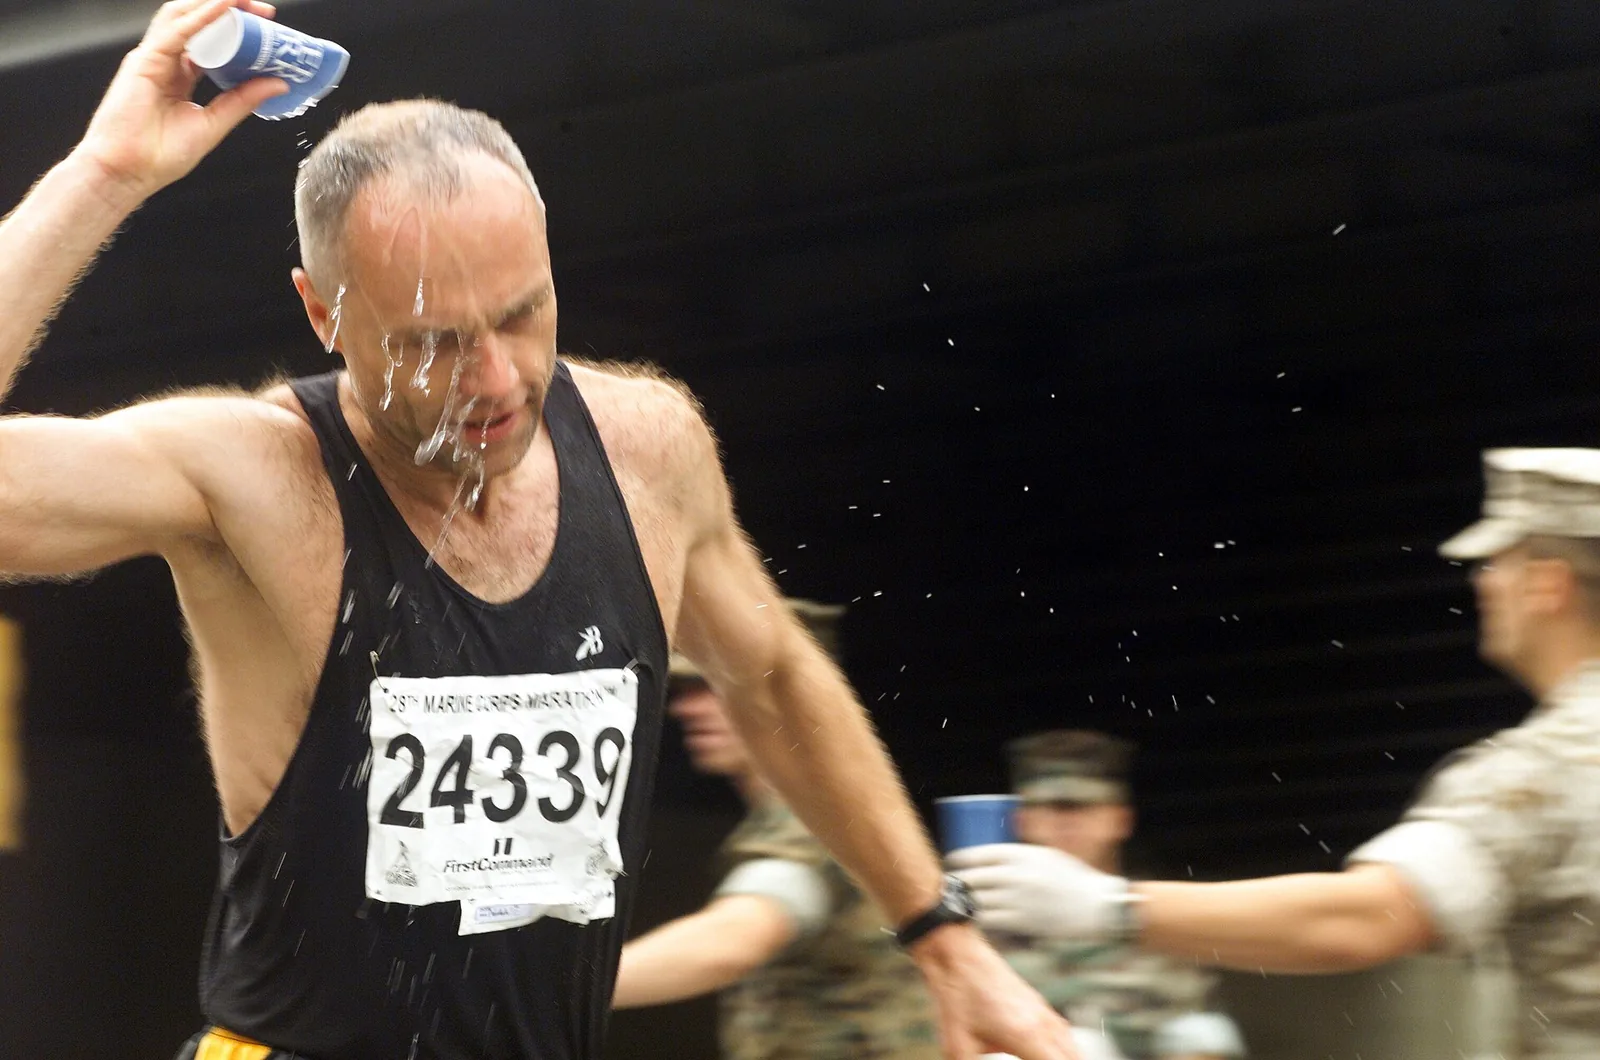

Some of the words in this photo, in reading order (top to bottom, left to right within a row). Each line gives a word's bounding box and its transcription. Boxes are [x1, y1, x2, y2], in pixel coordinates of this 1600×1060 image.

[424, 694, 473, 714] MARINE
[476, 692, 522, 713] CORPS
[525, 688, 604, 711] MARATHON
[379, 726, 625, 830] 24339
